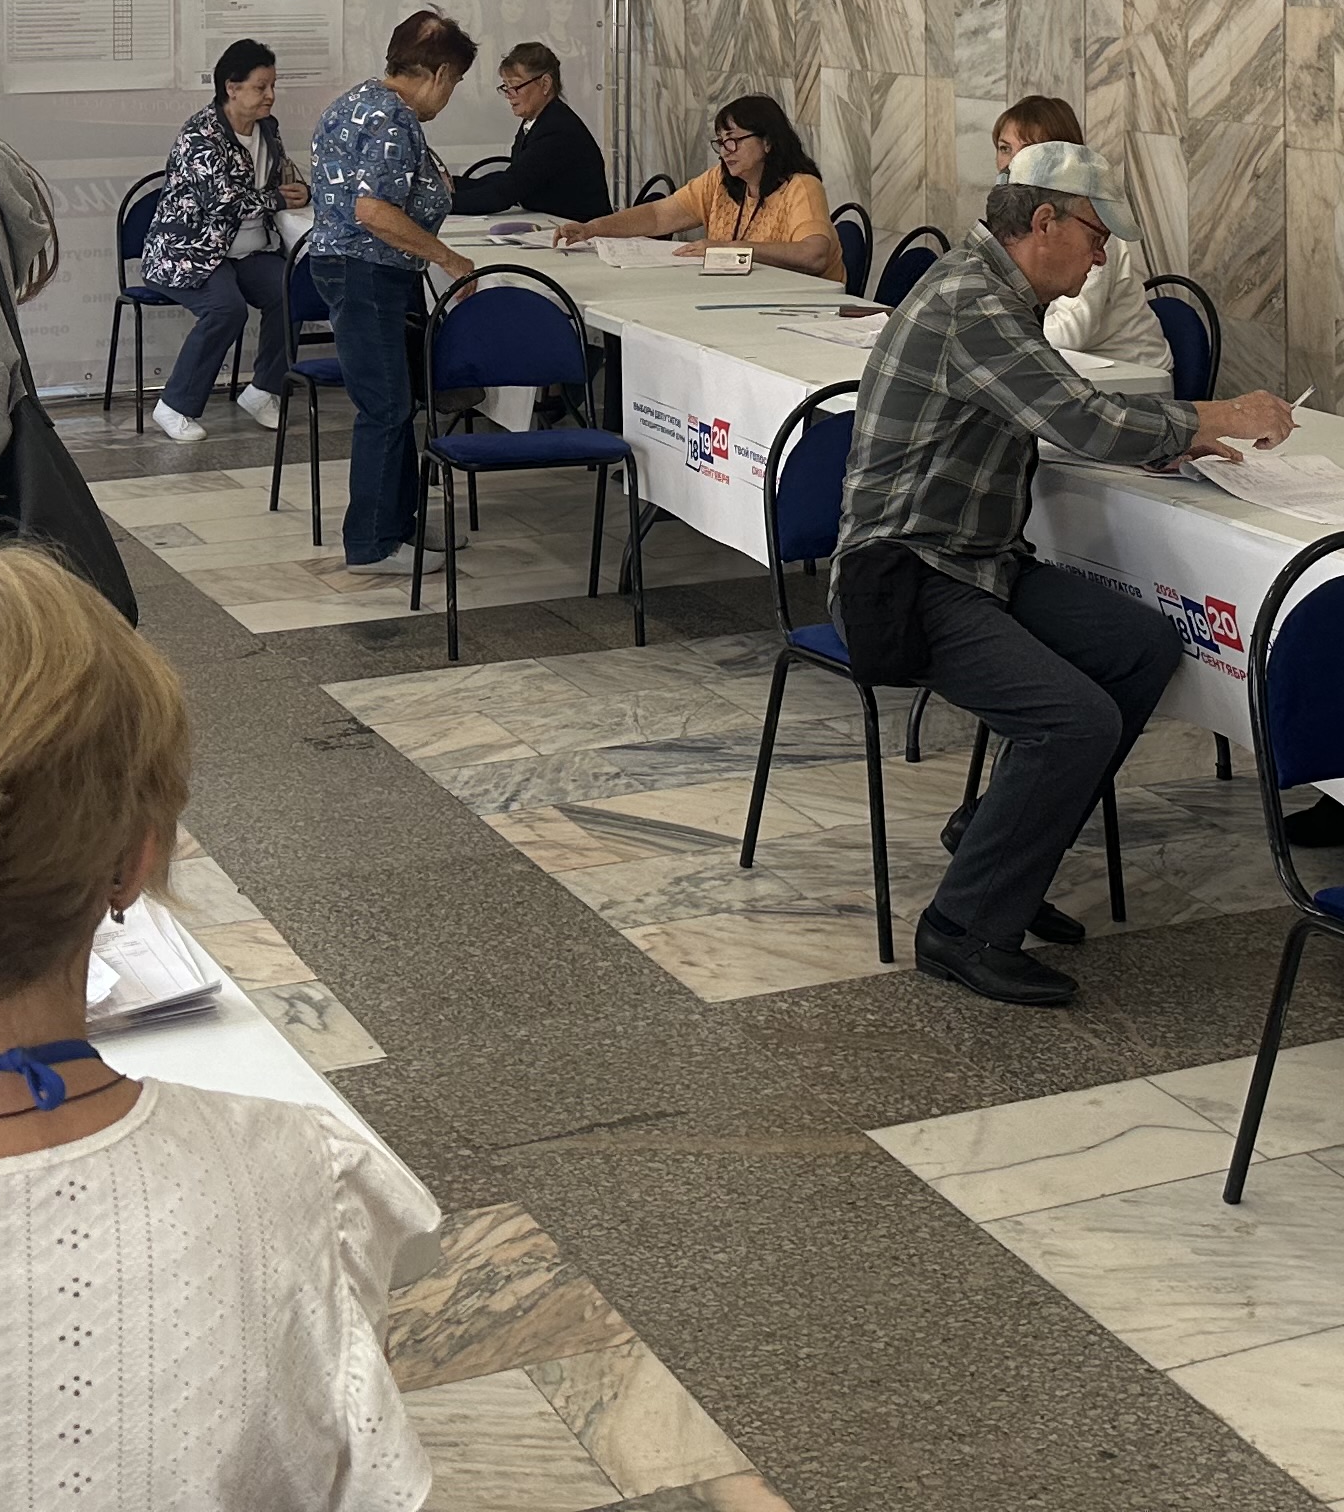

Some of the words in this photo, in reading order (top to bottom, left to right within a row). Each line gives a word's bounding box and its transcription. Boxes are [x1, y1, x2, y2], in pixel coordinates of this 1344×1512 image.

[690, 439, 699, 461] 18
[700, 431, 711, 456] 19
[713, 425, 728, 451] 20
[1186, 609, 1211, 641] 19
[1207, 605, 1238, 640] 20
[1201, 651, 1246, 681] СЕНТЯБР
